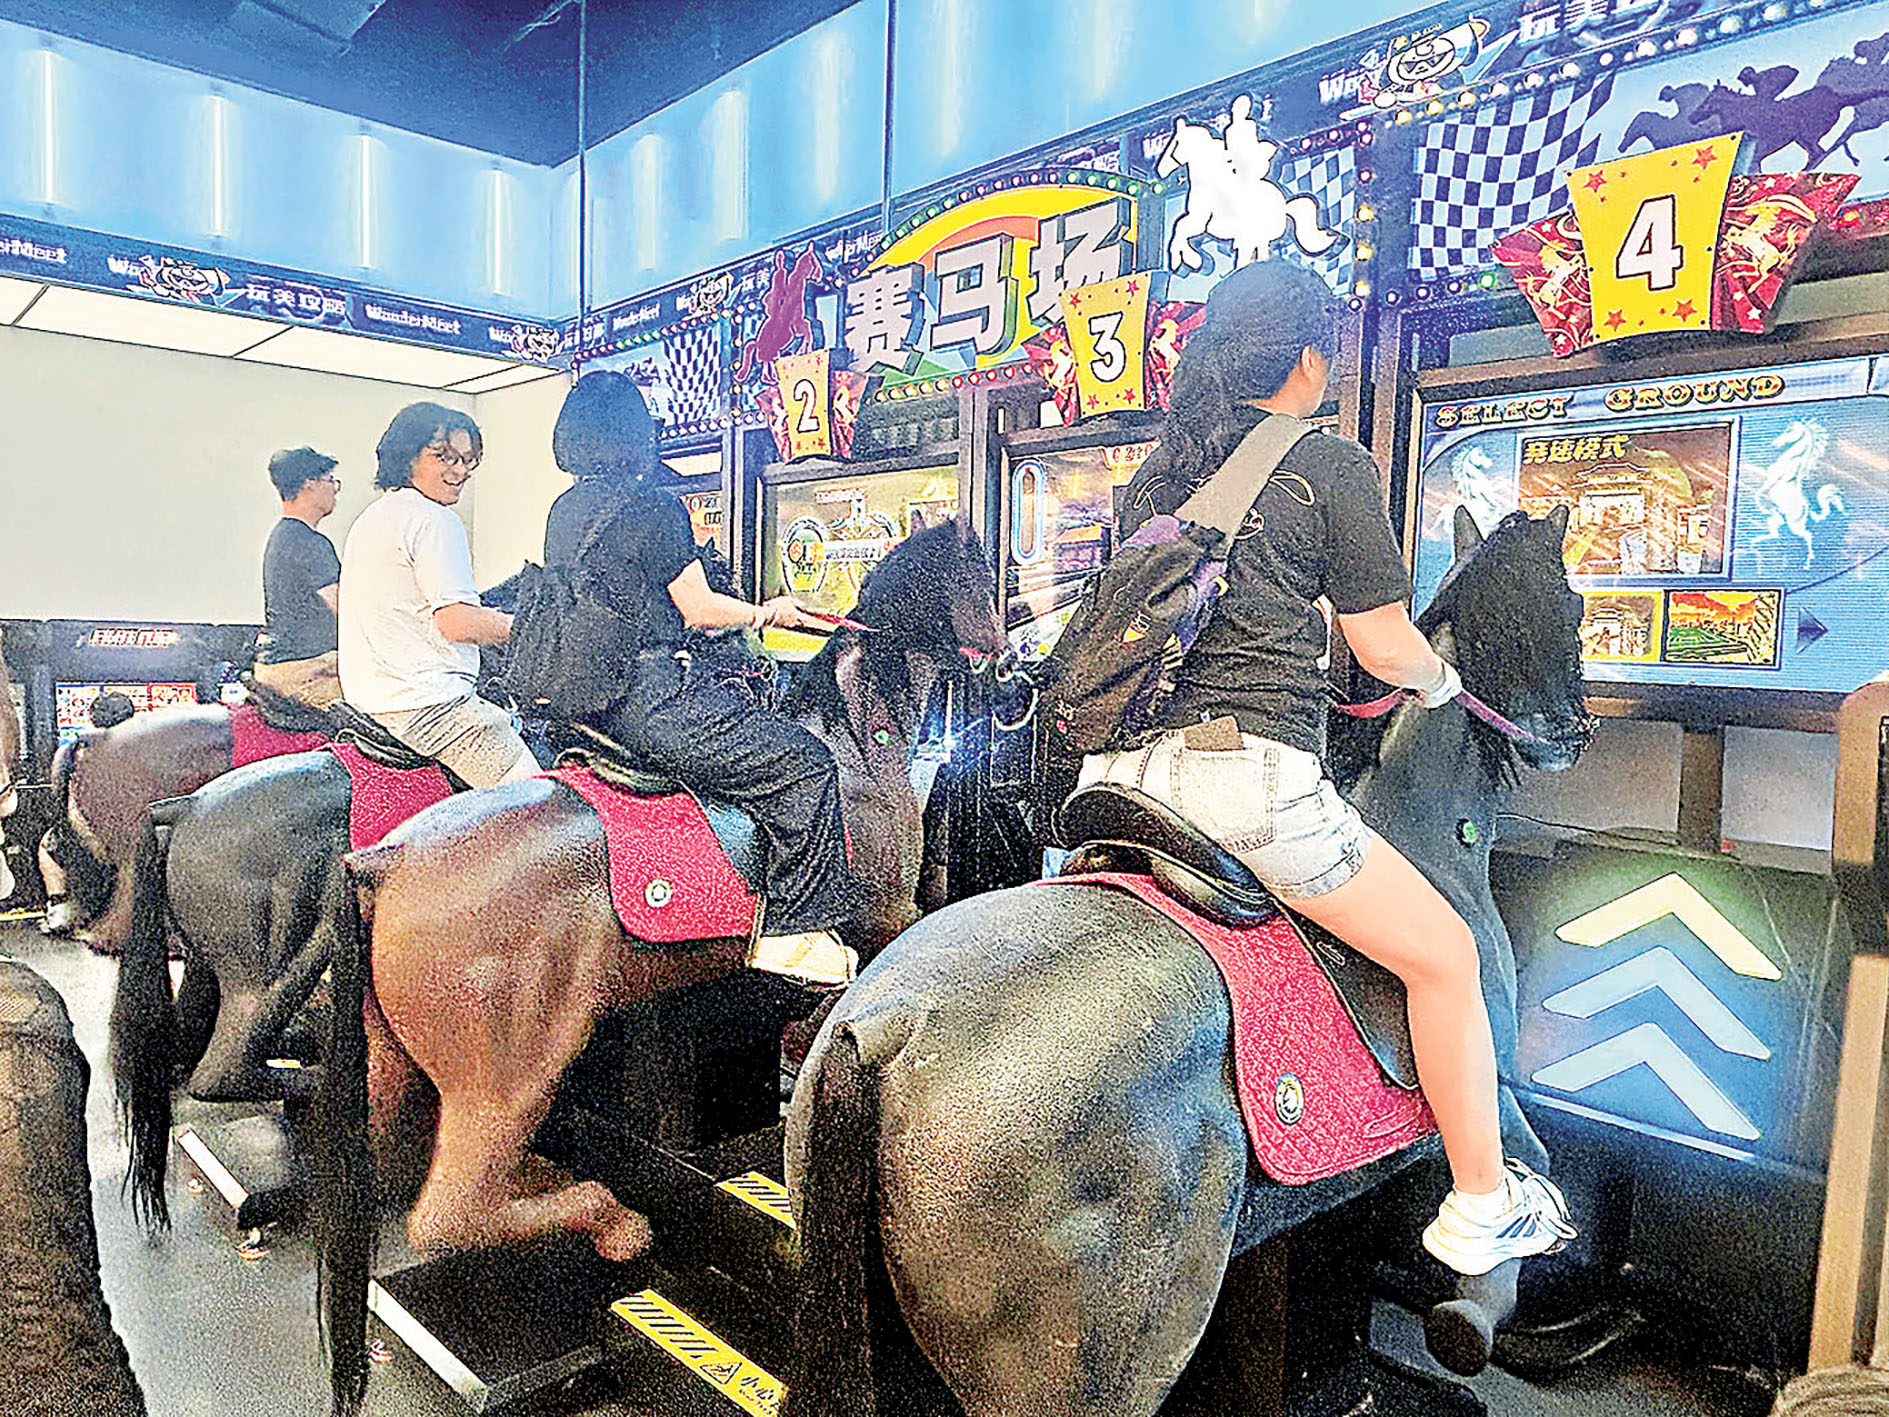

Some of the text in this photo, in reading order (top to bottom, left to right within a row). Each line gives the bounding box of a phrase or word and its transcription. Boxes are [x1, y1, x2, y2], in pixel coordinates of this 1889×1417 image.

[1616, 194, 1684, 292] 4
[845, 198, 1124, 373] 赛马场
[1086, 311, 1127, 382] 3
[793, 378, 821, 434] 2
[1435, 374, 1787, 428] SELECT GROUND
